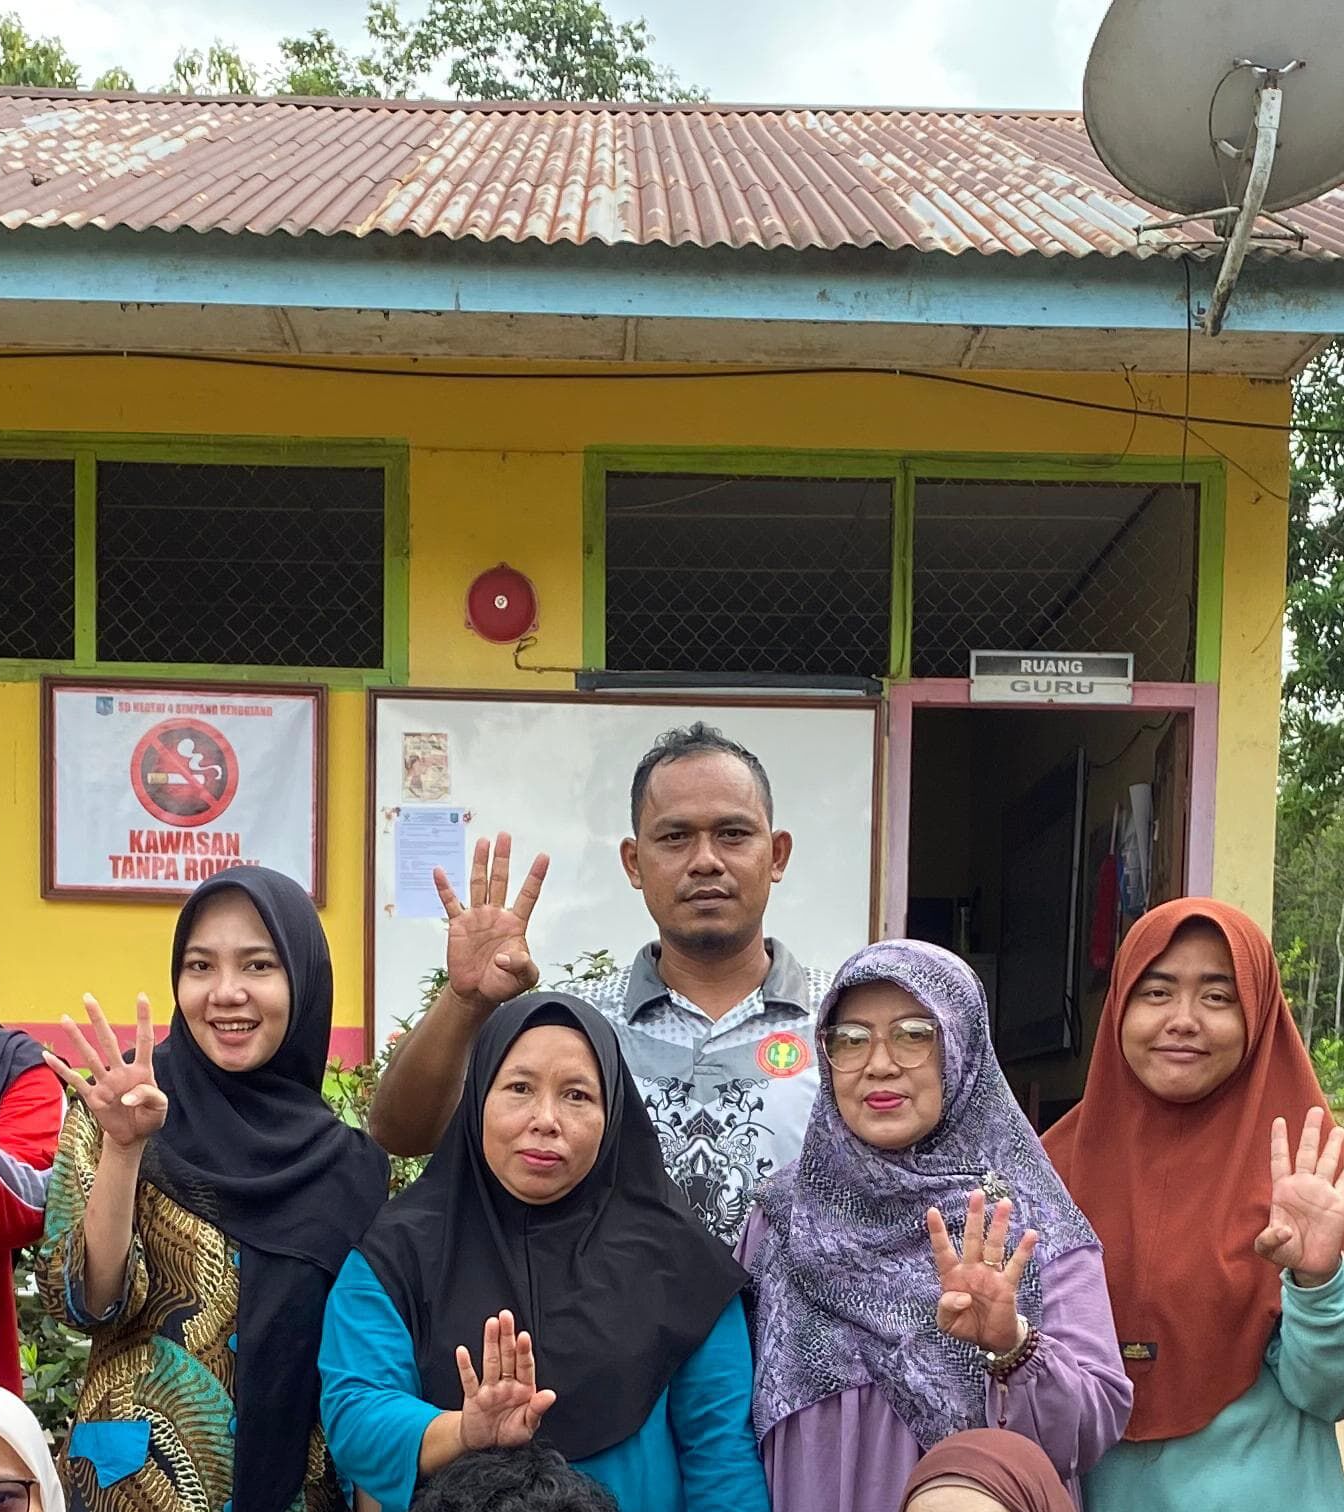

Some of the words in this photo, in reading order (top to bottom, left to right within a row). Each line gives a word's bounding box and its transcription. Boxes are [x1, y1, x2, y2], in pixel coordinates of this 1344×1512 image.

[1020, 659, 1083, 673] RUANG
[1010, 680, 1094, 694] GURU
[176, 704, 219, 716] SIMPANG
[129, 830, 240, 856] KAWASAN
[109, 855, 178, 880] TANPA
